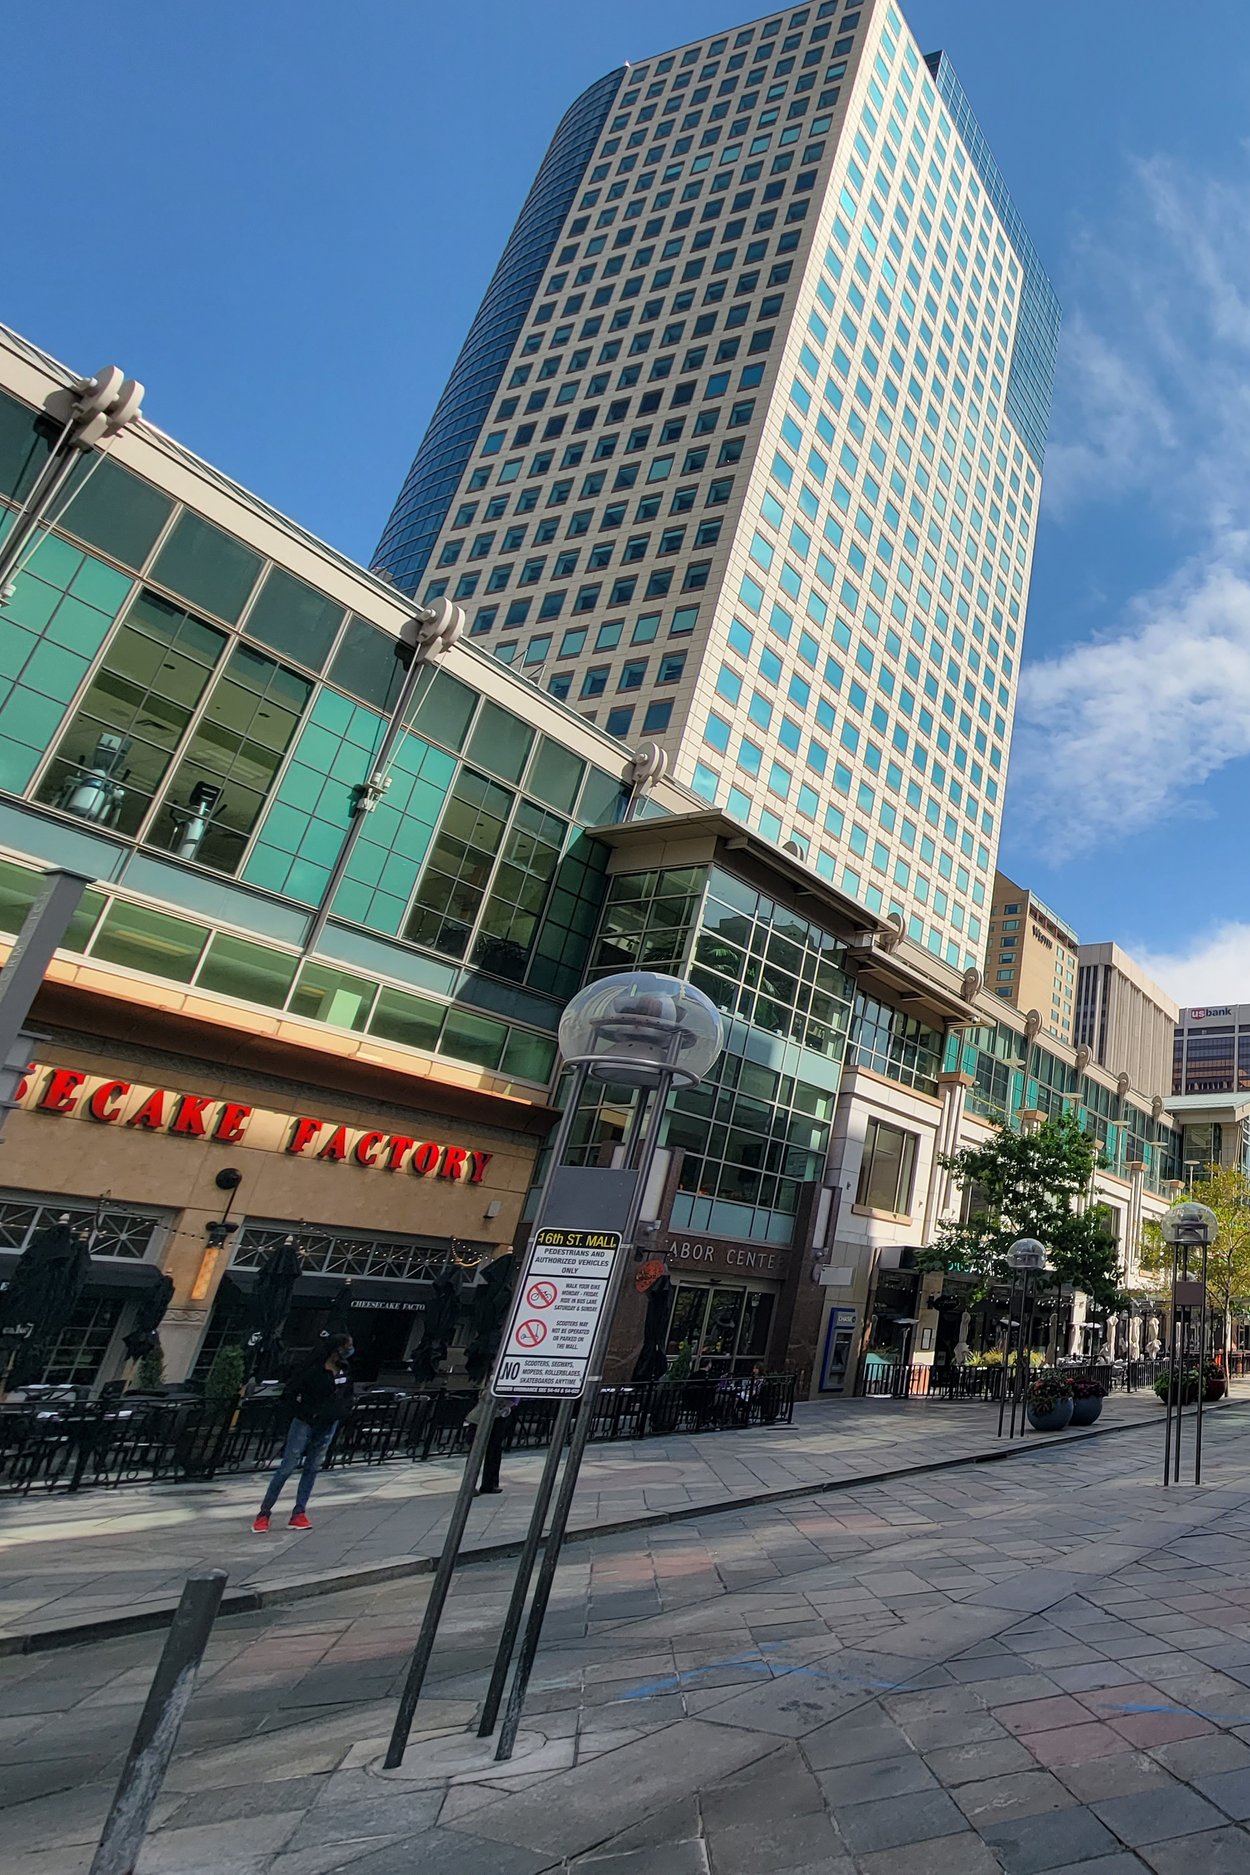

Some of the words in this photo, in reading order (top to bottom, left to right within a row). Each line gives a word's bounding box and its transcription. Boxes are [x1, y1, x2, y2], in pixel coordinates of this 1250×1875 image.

[286, 1117, 493, 1183] FACTORY
[539, 1232, 563, 1245] 16th
[566, 1234, 582, 1246] ST.
[586, 1236, 616, 1248] MALL
[544, 1248, 590, 1257] PEDESTRIANS
[665, 1240, 714, 1262] ABOR
[726, 1249, 784, 1270] CENTE
[535, 1256, 576, 1265] AUTHORIZED
[578, 1259, 609, 1267] VEHICLES
[350, 1300, 400, 1310] CHEESECAKE
[501, 1362, 521, 1380] NO
